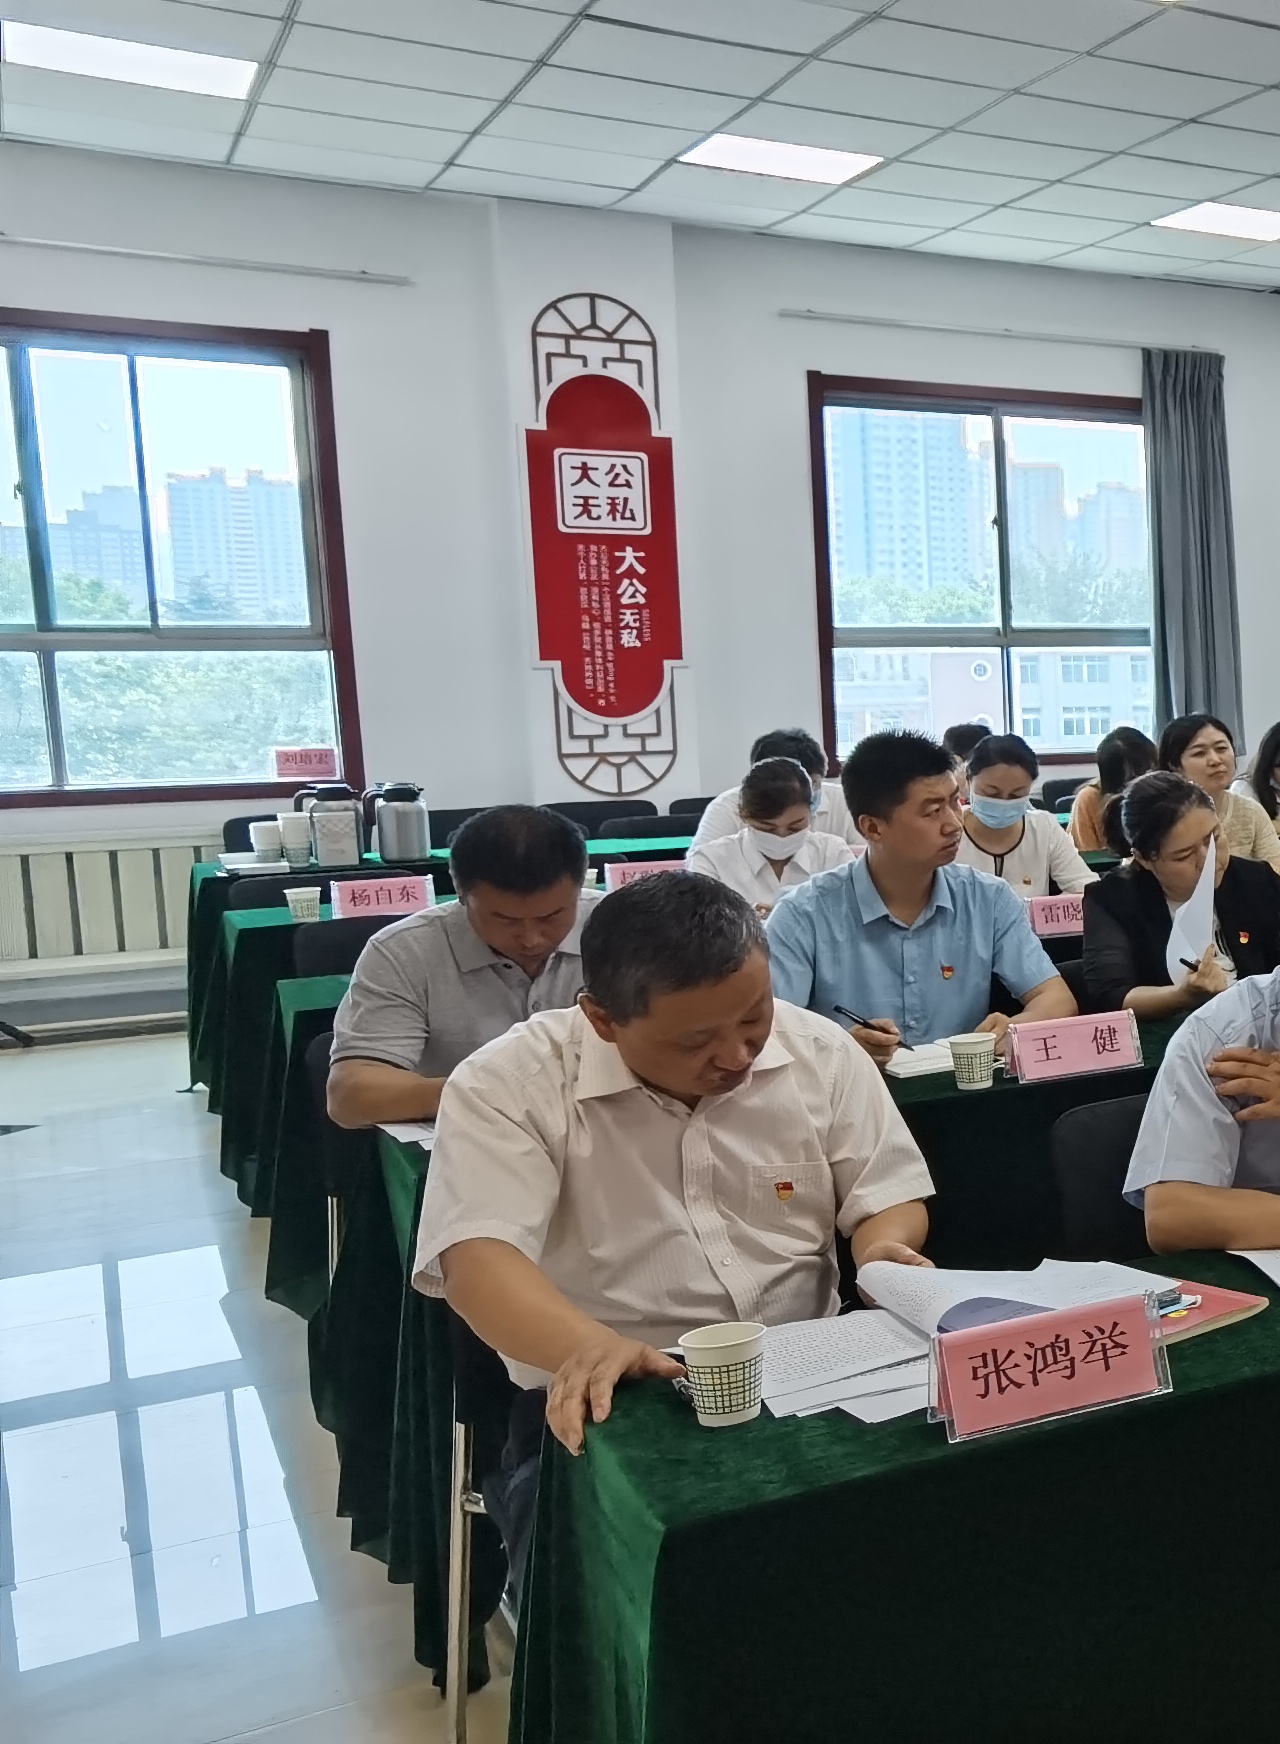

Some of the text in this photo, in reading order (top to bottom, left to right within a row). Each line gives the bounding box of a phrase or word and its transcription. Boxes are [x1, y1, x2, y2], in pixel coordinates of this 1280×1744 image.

[614, 546, 648, 648] 大公无私
[349, 885, 419, 907] 杨自东
[1031, 1025, 1121, 1063] 王健
[967, 1320, 1131, 1400] 张鸿举
